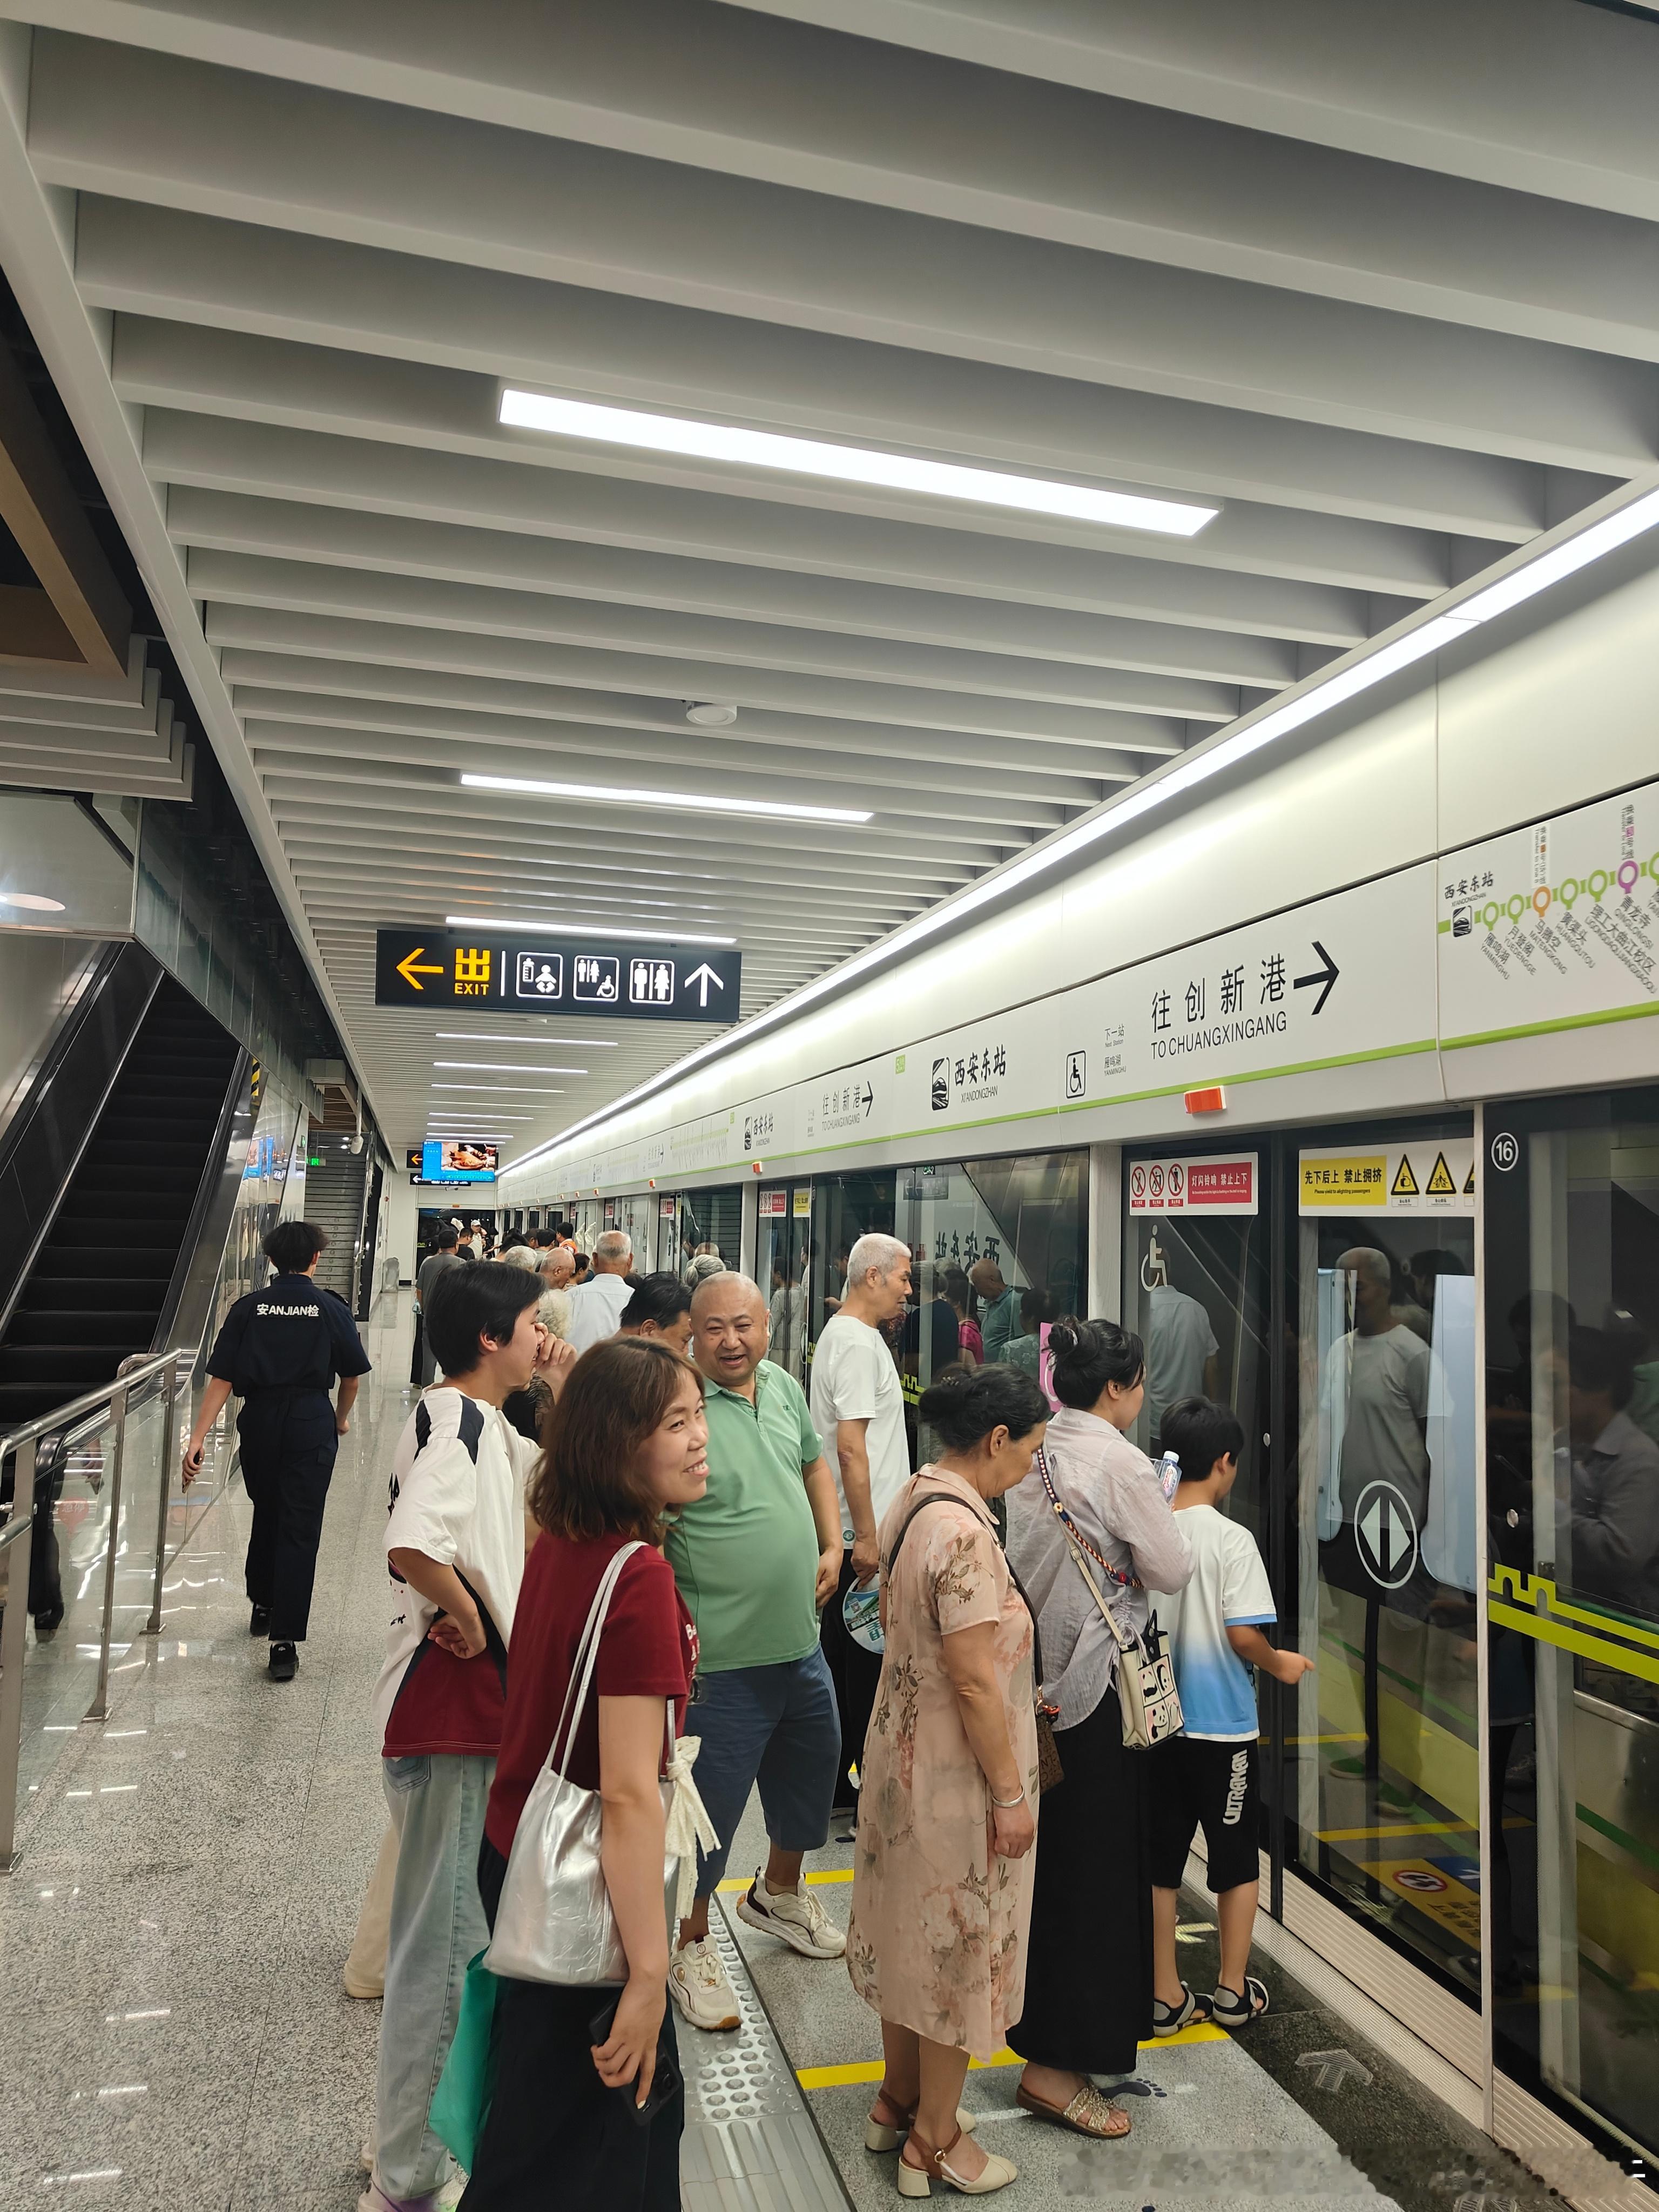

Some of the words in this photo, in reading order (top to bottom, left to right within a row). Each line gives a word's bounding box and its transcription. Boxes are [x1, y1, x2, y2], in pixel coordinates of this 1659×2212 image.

[1445, 871, 1493, 899] 西安东站
[1621, 895, 1651, 928] 青龙寺
[455, 948, 490, 981] 出
[455, 982, 489, 995] EXIT
[1151, 953, 1286, 1034] 往创新港
[1104, 1023, 1124, 1041] 下一站
[955, 1044, 1006, 1086] 西安东站
[822, 1084, 860, 1116] 往创新港
[753, 1112, 774, 1136] 西安东站
[1496, 1141, 1513, 1161] 16
[1192, 1174, 1217, 1187] 灯闪铃响
[1220, 1172, 1247, 1186] 禁止上下
[1305, 1169, 1340, 1185] 先下后上
[1344, 1167, 1382, 1184] 禁止拥挤
[257, 1303, 320, 1317] 安ANJIAN检
[1223, 1749, 1249, 1825] ULTRAMAN
